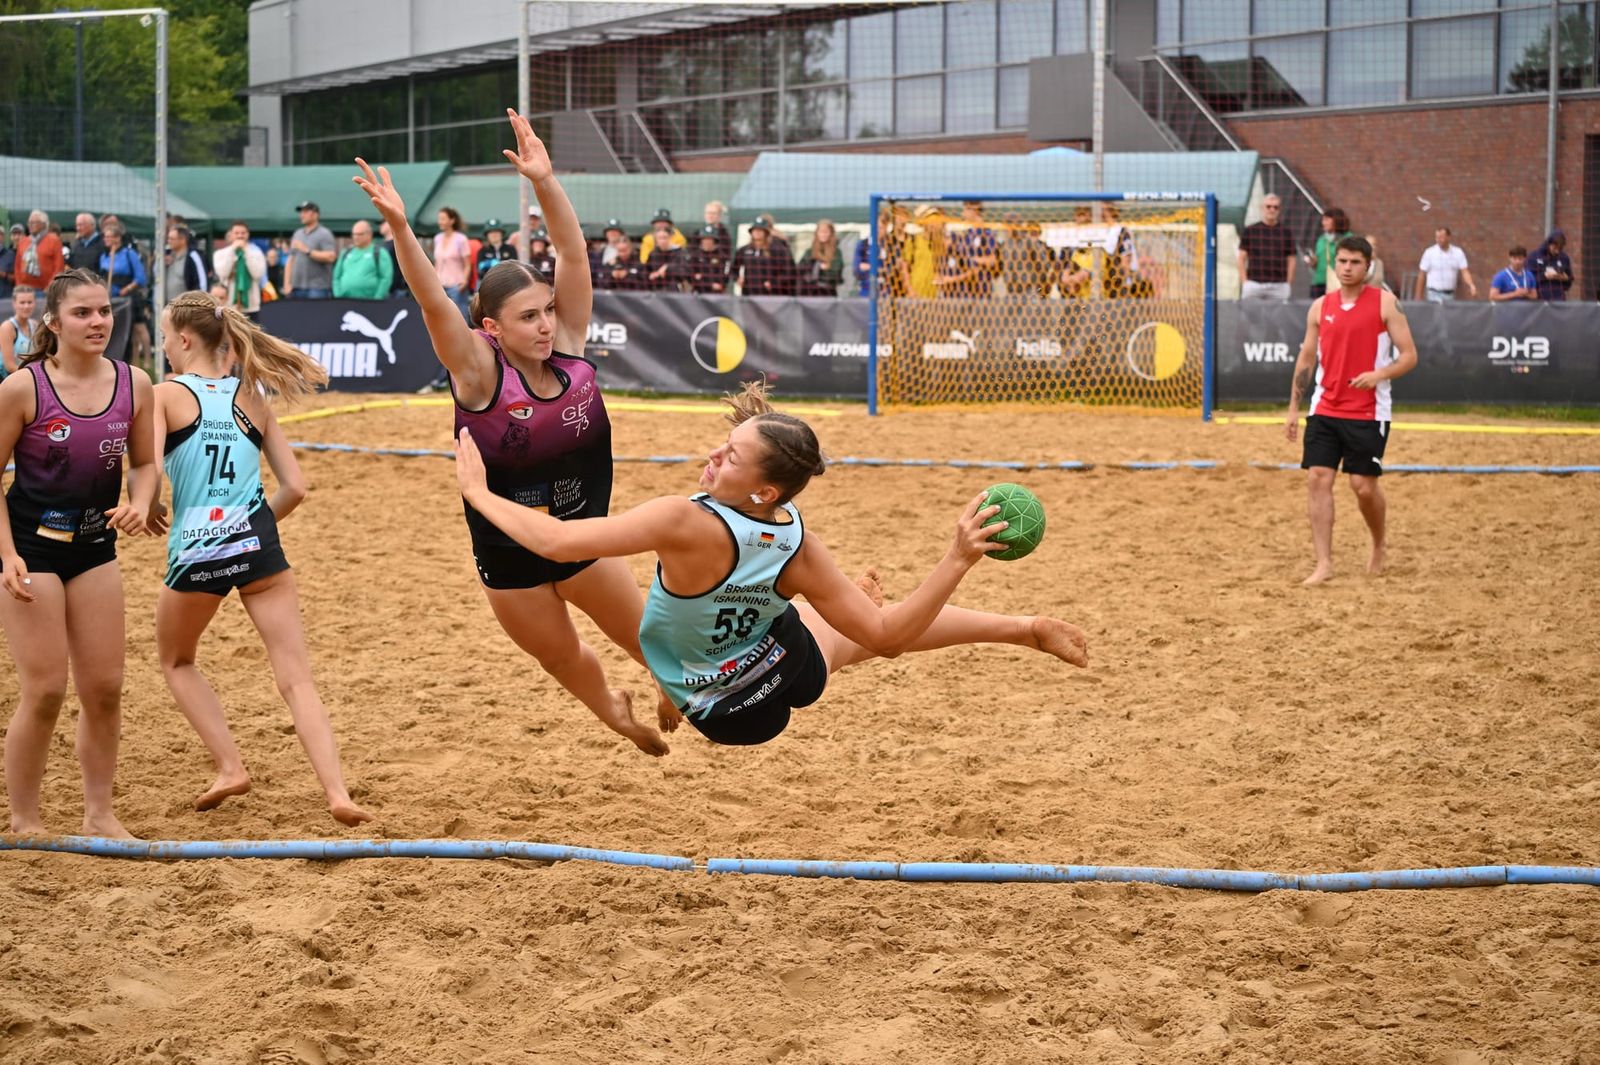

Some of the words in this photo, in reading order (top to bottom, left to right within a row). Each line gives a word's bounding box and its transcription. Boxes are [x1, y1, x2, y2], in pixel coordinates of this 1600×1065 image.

[585, 322, 627, 344] HB
[808, 342, 893, 357] AUTOHEO
[923, 343, 969, 360] PUMA
[1016, 337, 1062, 358] hella
[1243, 342, 1295, 362] WIR.
[1487, 336, 1550, 359] DHB
[290, 342, 379, 377] UMA
[203, 420, 234, 430] BRÜDER
[201, 431, 238, 442] ISMANING
[106, 457, 117, 470] 5
[205, 444, 236, 485] 74
[208, 488, 230, 498] KOCH
[182, 521, 249, 540] DATAGROUP
[757, 541, 772, 550] GER
[724, 584, 770, 594] BRÜDER
[713, 595, 771, 607] ISMANING
